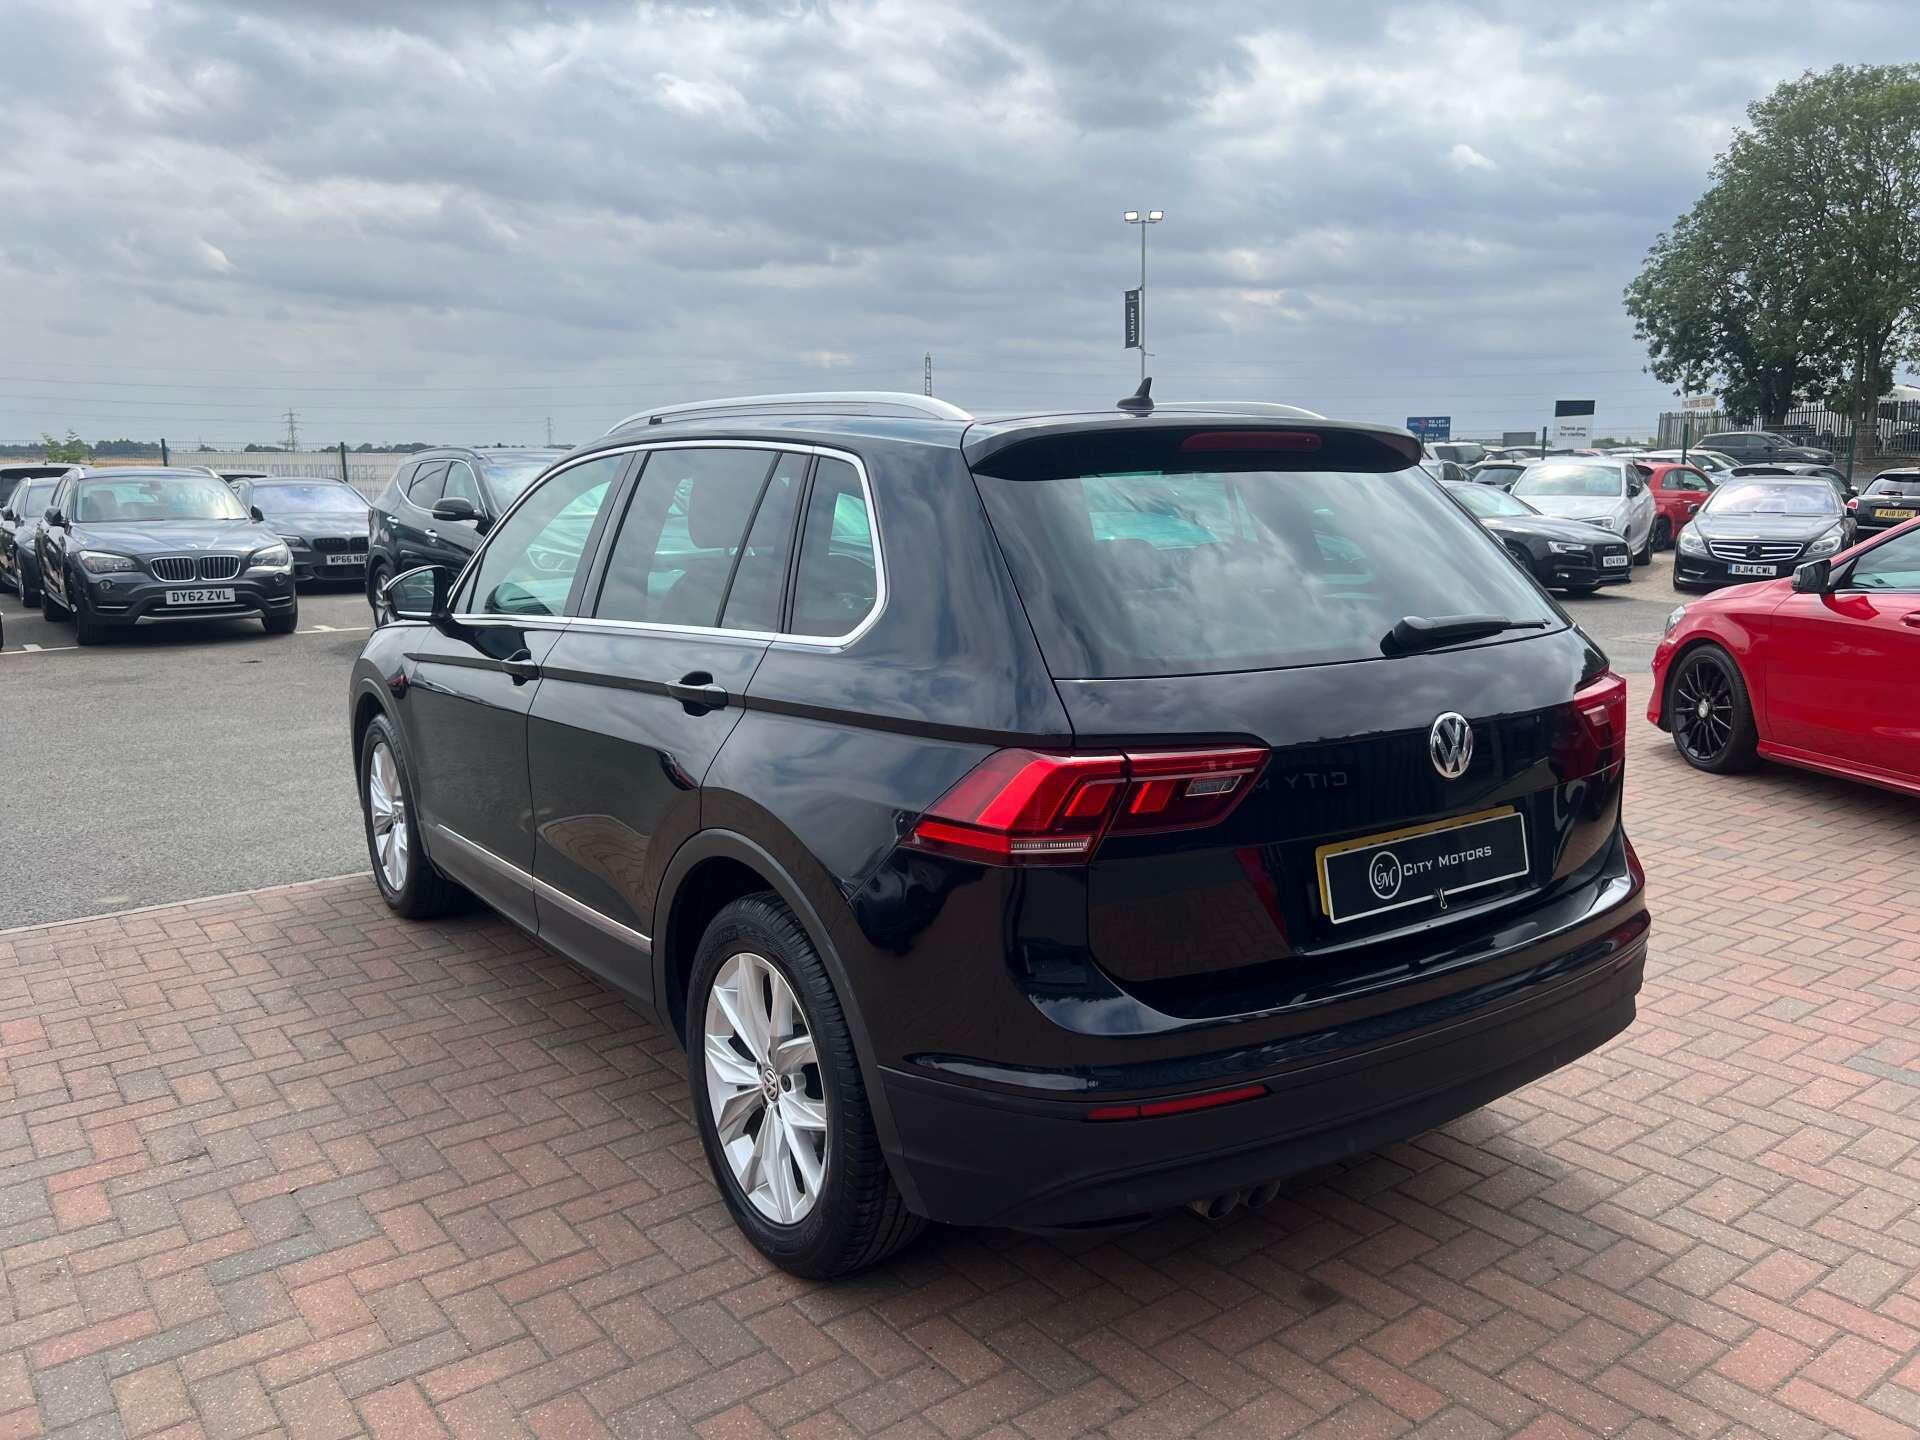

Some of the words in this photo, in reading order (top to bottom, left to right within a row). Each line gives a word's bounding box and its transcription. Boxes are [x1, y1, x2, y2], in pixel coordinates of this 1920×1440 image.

[1735, 565, 1754, 574] BJ14
[1755, 566, 1774, 575] CWL
[171, 591, 204, 603] DY62
[207, 590, 230, 602] ZVL
[1403, 858, 1433, 877] CITY
[1438, 845, 1493, 868] MOTORS
